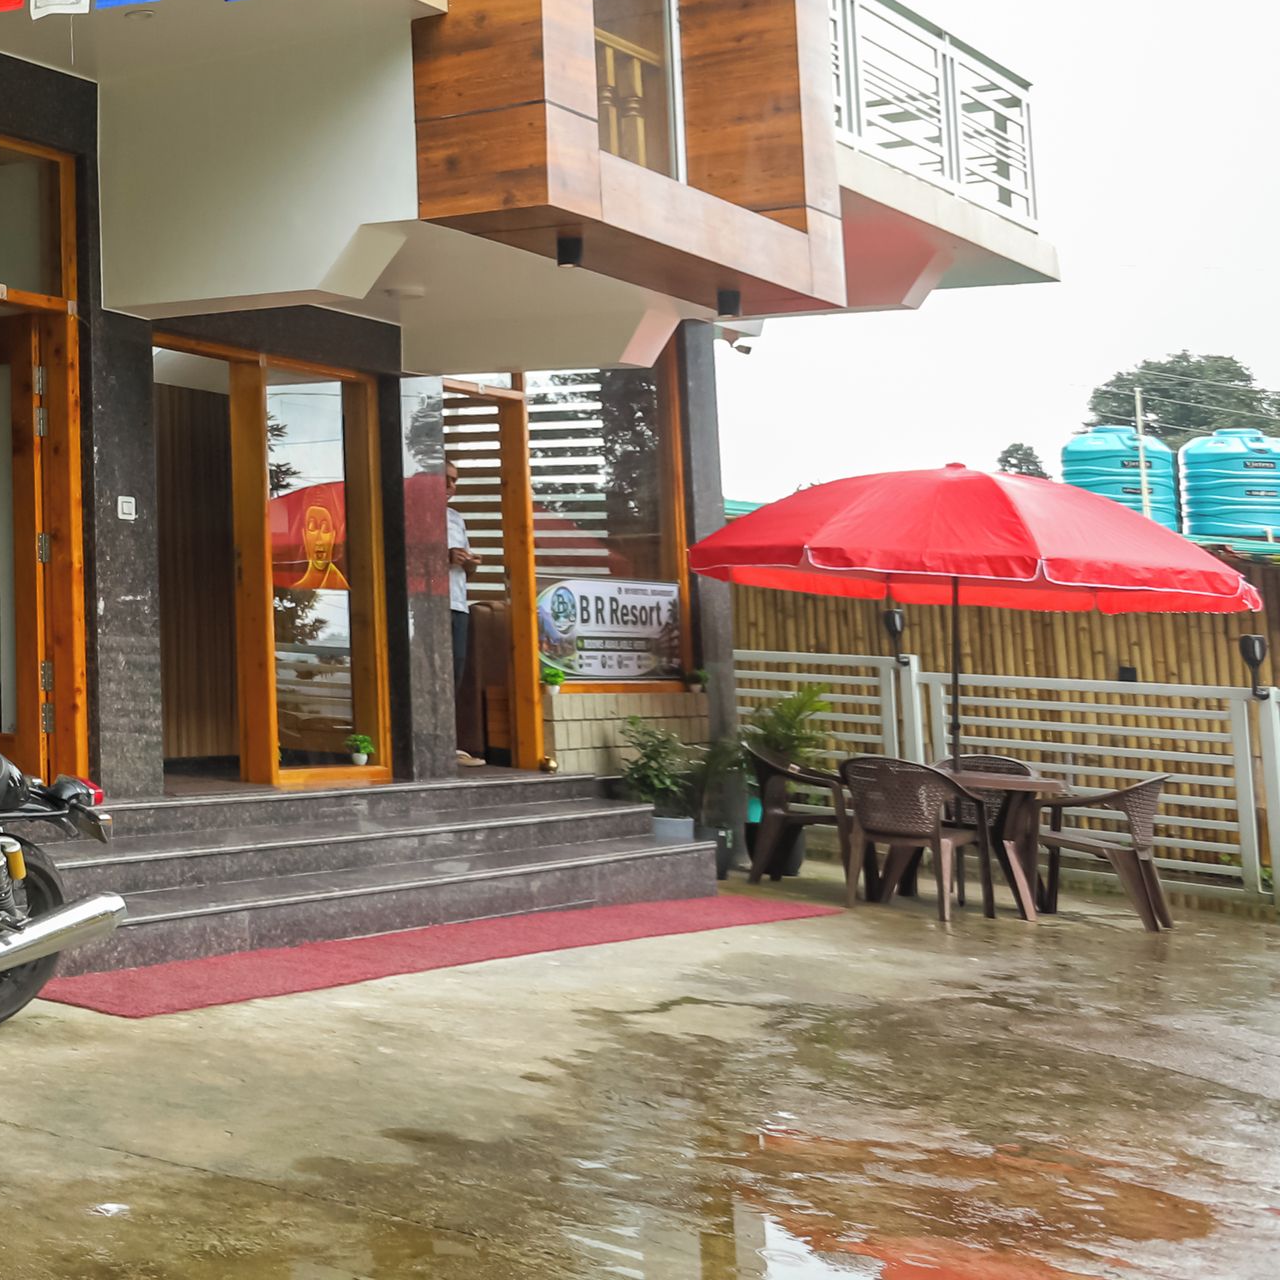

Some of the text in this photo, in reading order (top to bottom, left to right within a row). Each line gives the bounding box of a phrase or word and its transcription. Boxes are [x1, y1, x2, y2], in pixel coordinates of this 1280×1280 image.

[579, 595, 591, 624] B
[595, 595, 606, 625] R
[609, 596, 662, 627] Resort
